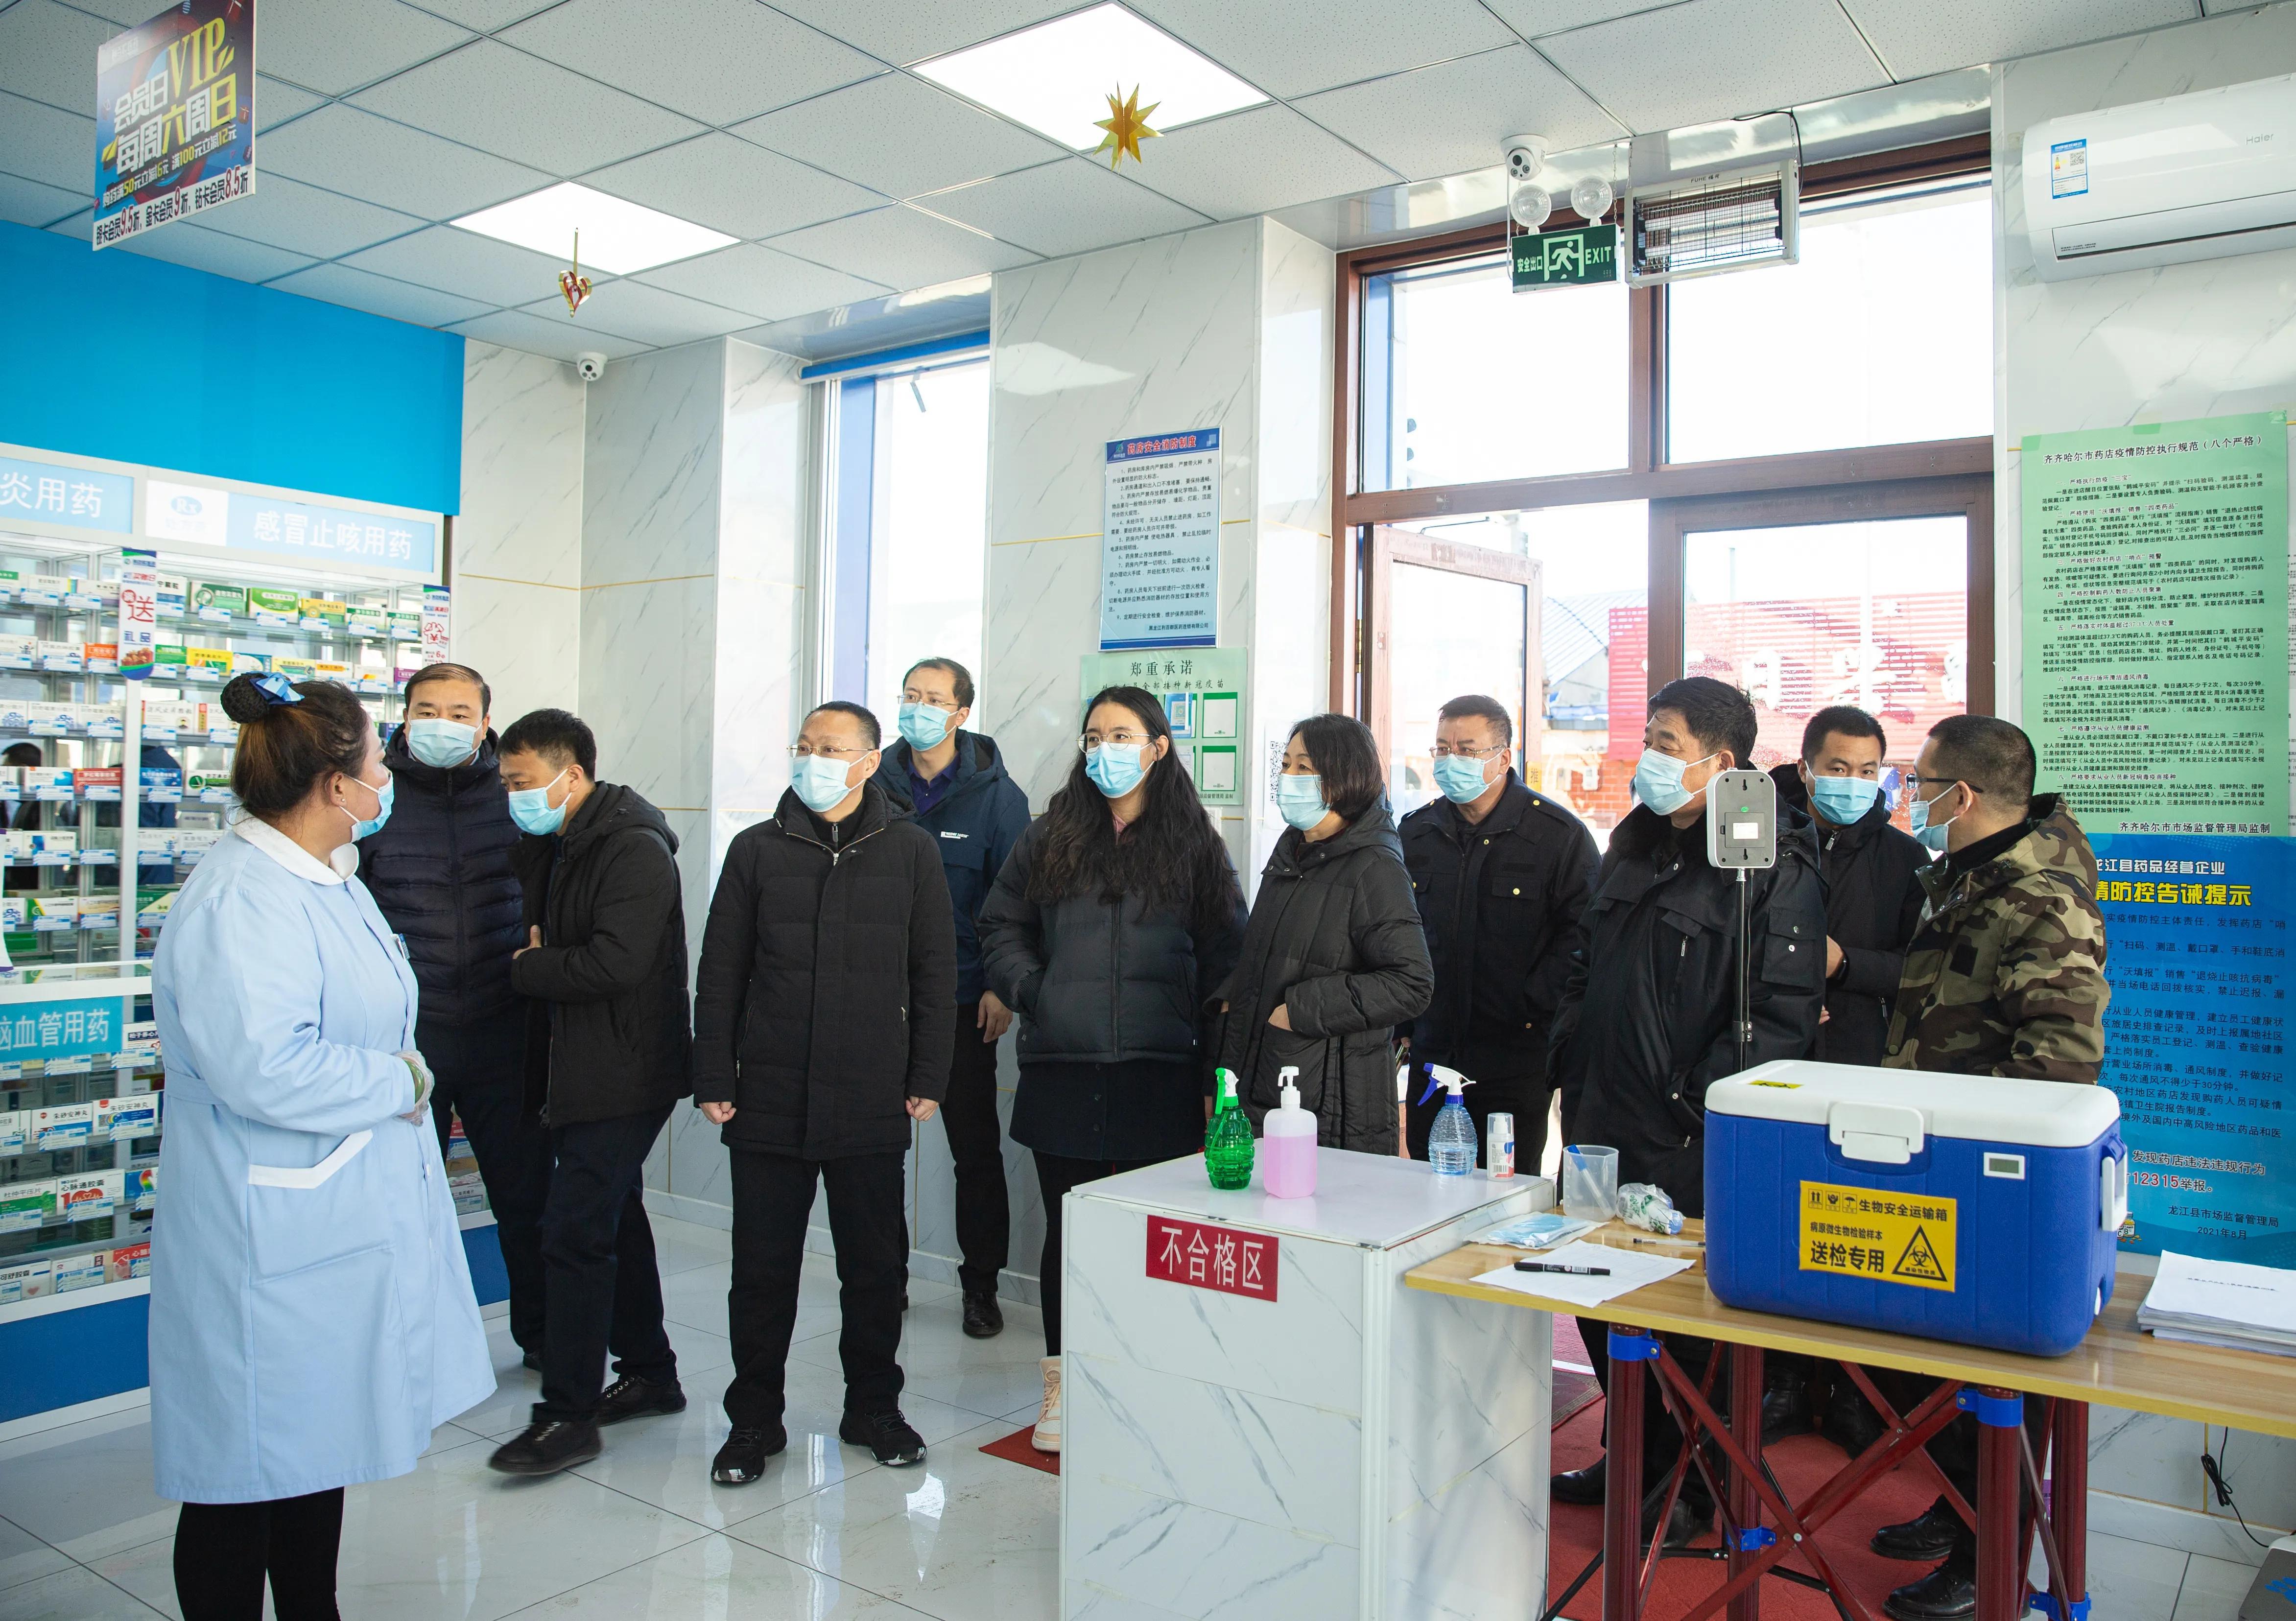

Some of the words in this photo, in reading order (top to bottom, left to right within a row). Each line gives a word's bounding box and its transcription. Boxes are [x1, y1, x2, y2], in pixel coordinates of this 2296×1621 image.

[115, 70, 168, 133] 会员日
[168, 18, 225, 97] VIP
[117, 73, 237, 175] 每周六周日
[2246, 133, 2274, 145] Haier
[1517, 256, 1543, 273] 安全出口
[1585, 246, 1611, 265] EXIT
[1128, 436, 1196, 455] 药房安全消防制度
[2043, 435, 2263, 465] 齐齐哈尔市药店疫情防控执行规范（八个严格）
[253, 509, 413, 561] 感冒止咳用药
[127, 596, 154, 623] 送
[1130, 660, 1193, 677] 郑重承诺
[2119, 822, 2271, 834] 齐齐哈尔市市场监督管理局监制
[2132, 1151, 2265, 1175] 发现药店违法违规行为
[61, 1179, 105, 1192] 心脉通胶囊
[2126, 1172, 2213, 1193] 12315举报。
[1859, 1199, 1947, 1222] 生物安全运输箱
[2168, 1206, 2278, 1227] 龙江县市场监督管理局
[1810, 1222, 1883, 1241] 病原微生物检验样本
[2198, 1226, 2247, 1240] 2021年8月
[1160, 1226, 1263, 1290] 不合格区
[1810, 1240, 1884, 1273] 送检专用
